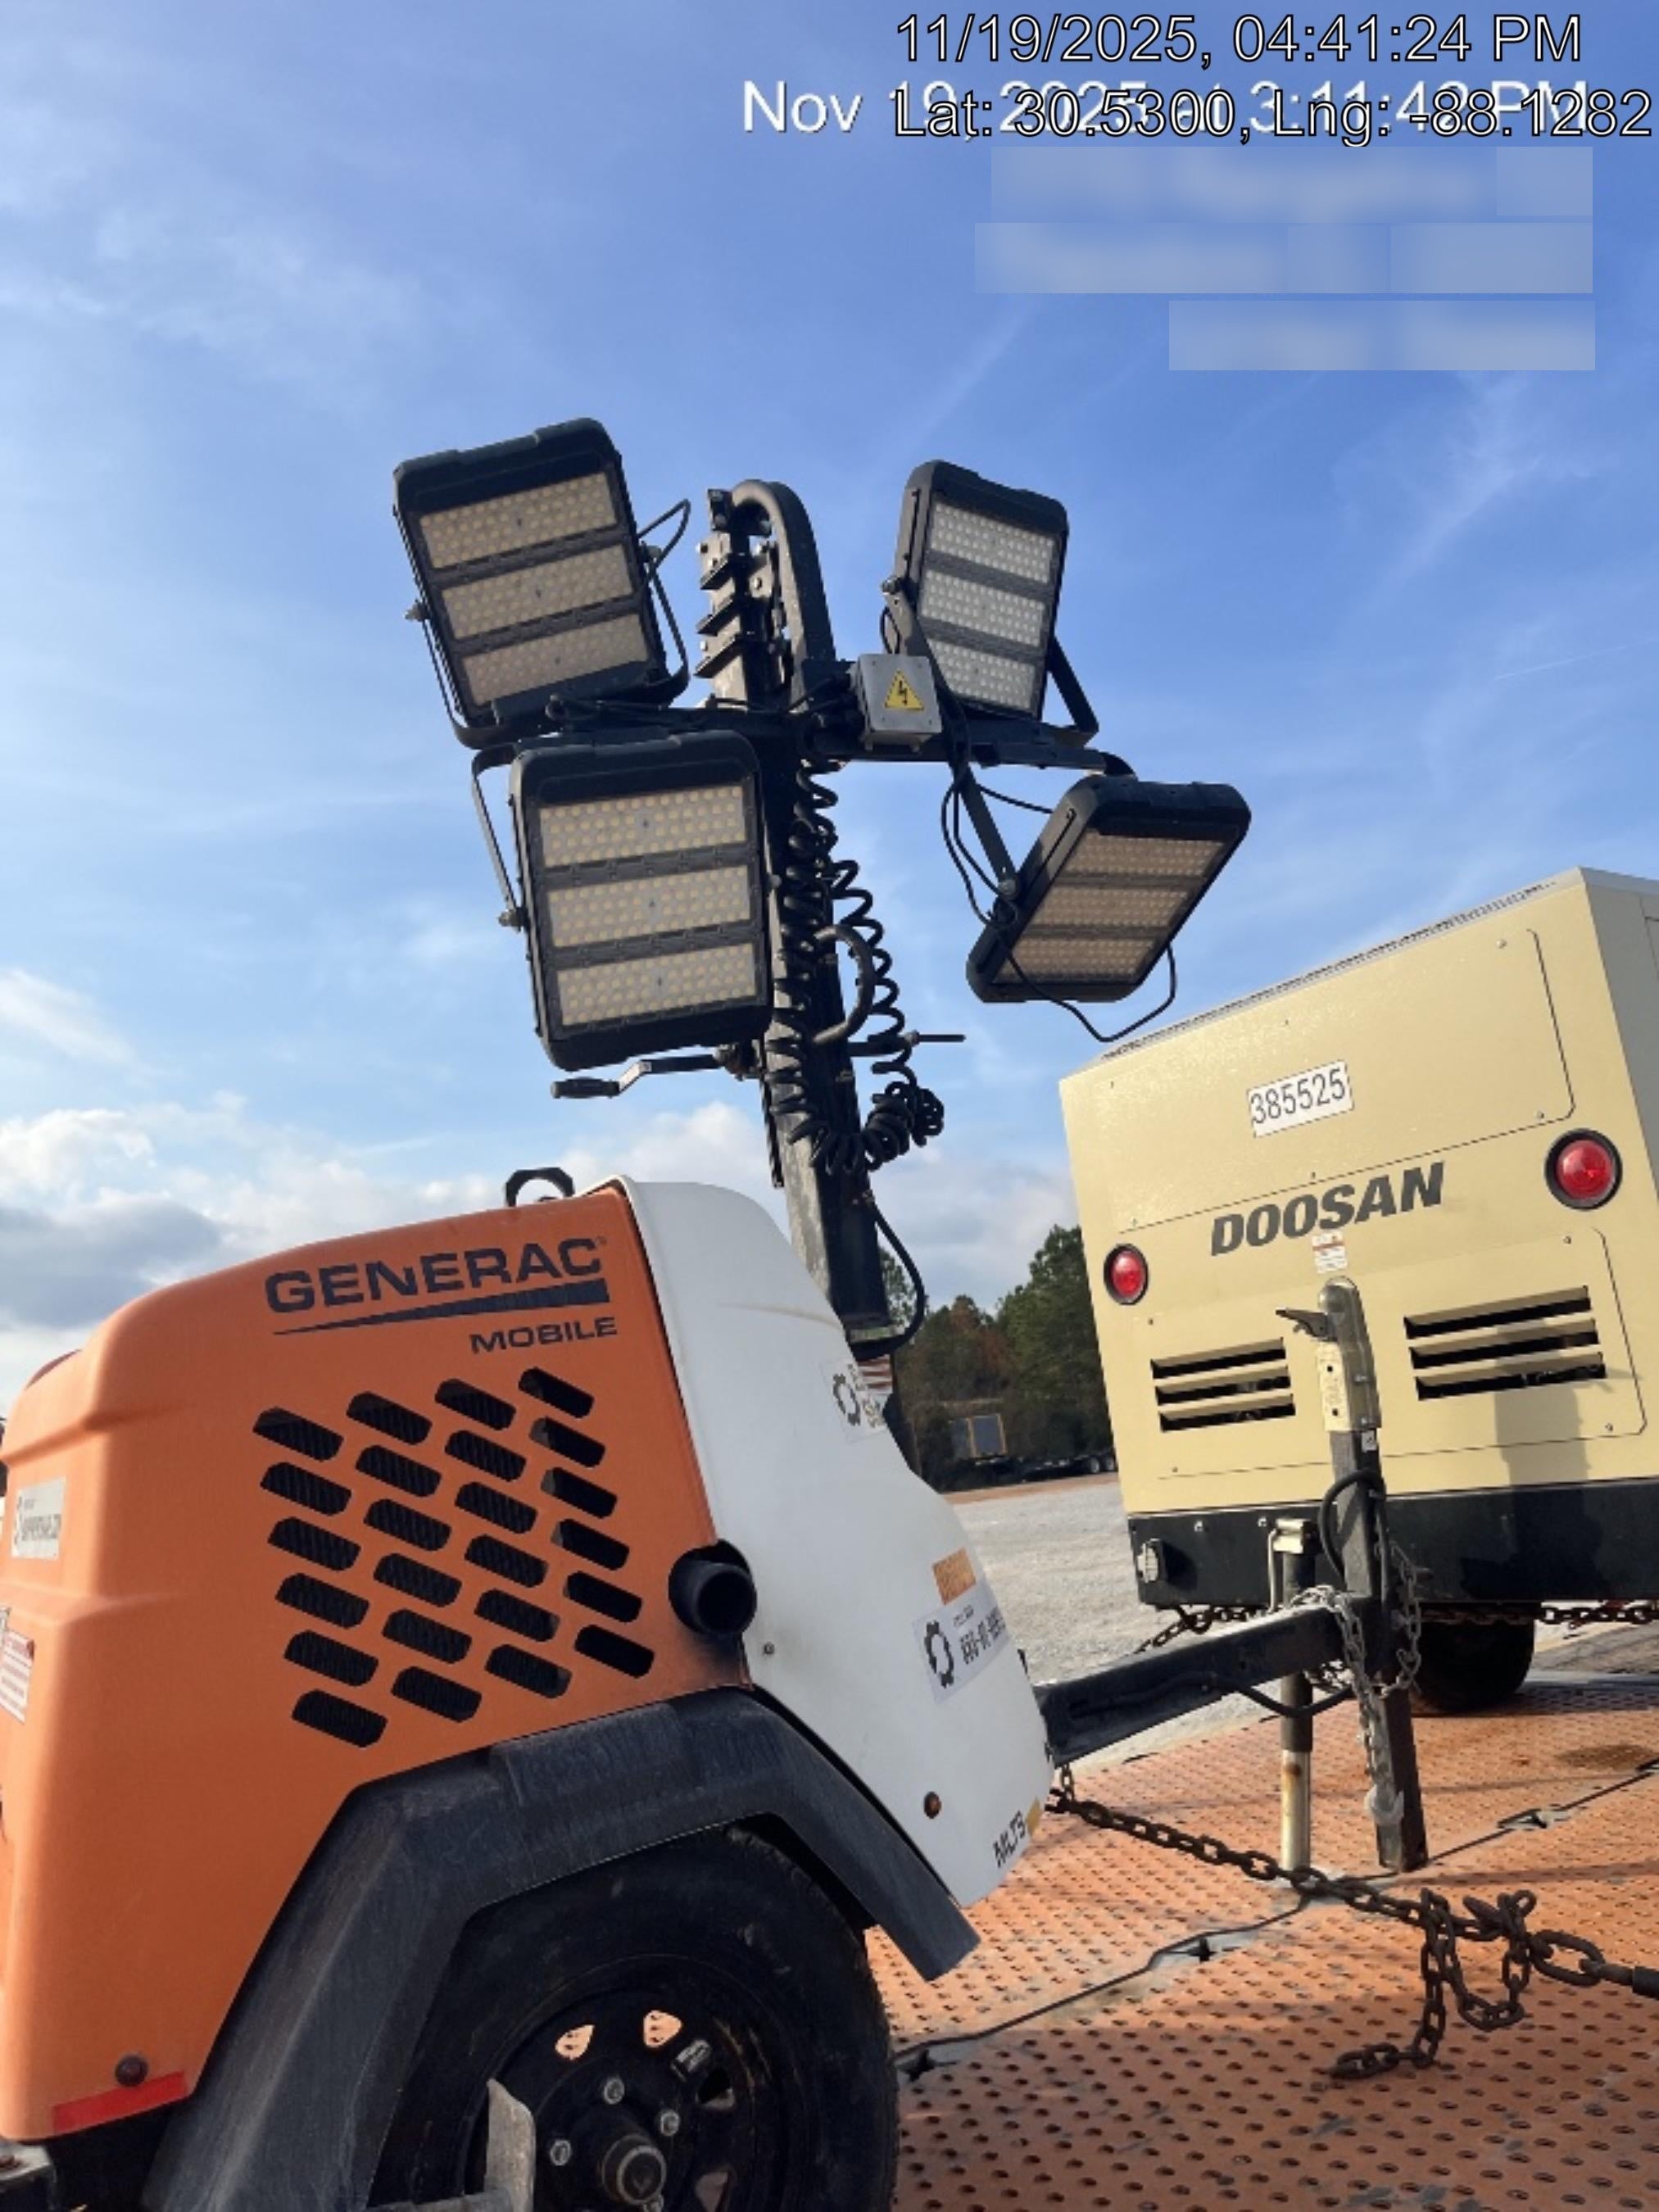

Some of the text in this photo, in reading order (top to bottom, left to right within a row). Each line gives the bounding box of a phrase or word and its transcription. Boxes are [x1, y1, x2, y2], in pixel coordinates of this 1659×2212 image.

[1250, 1067, 1346, 1125] 385525
[1211, 1160, 1445, 1257] DOOSAN
[265, 1236, 603, 1313] GENERAC
[469, 1316, 619, 1355] MOBILE
